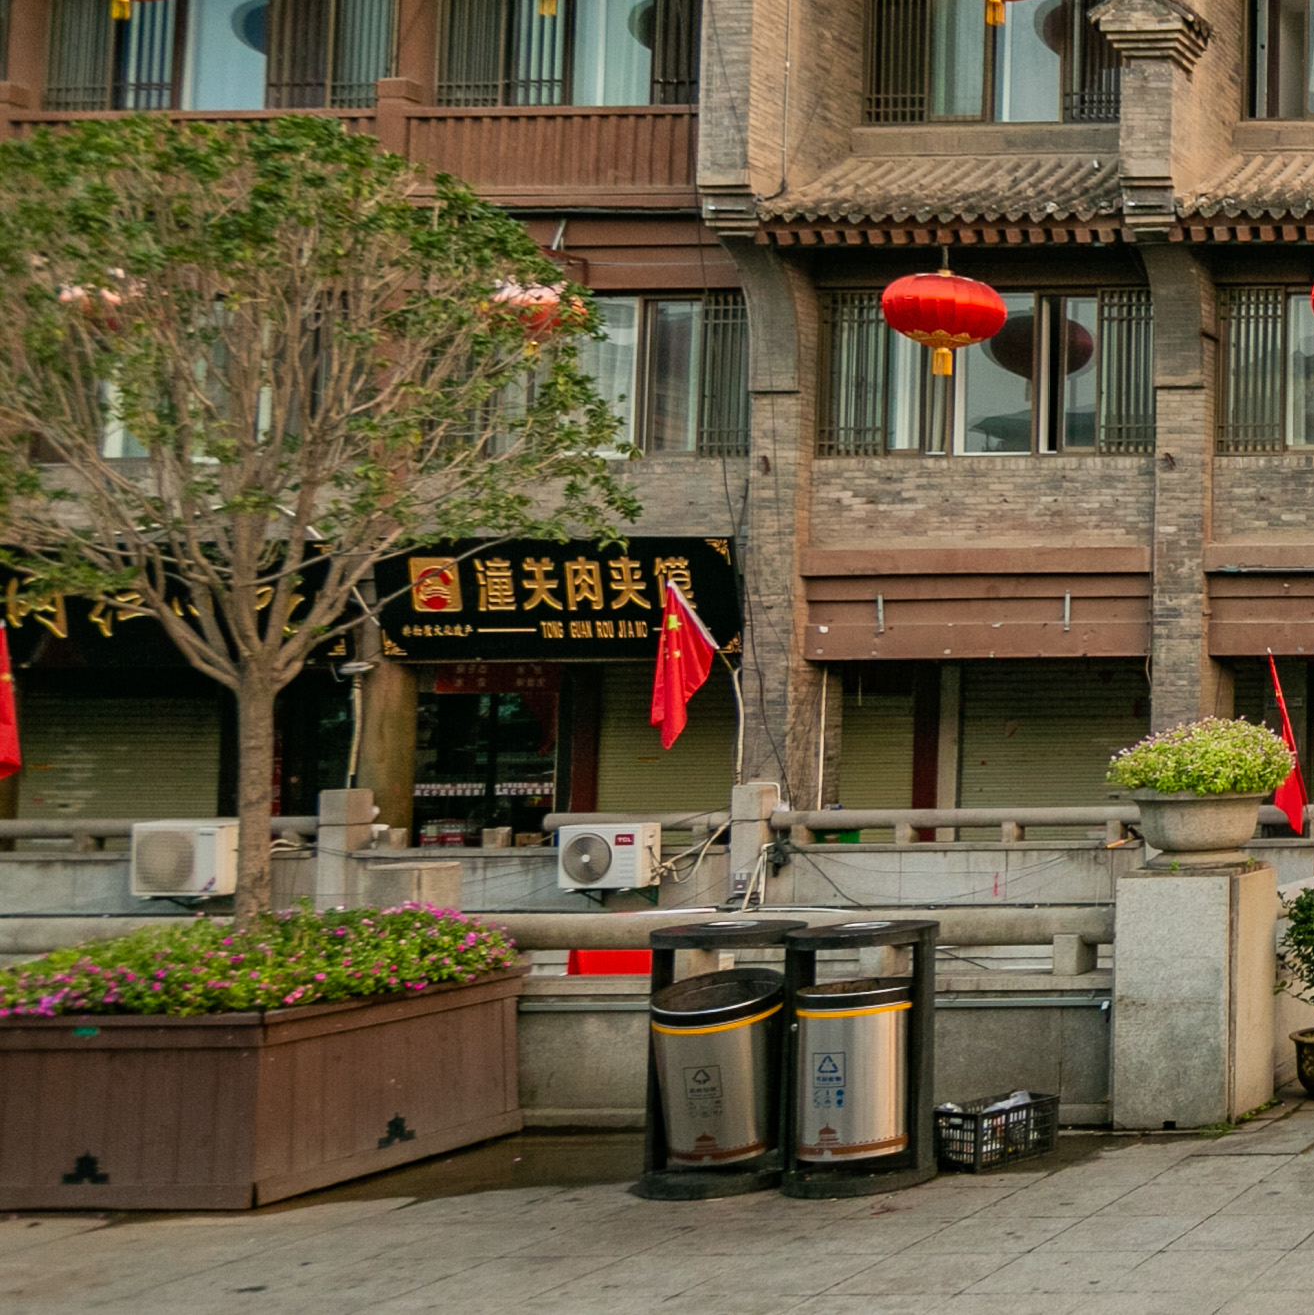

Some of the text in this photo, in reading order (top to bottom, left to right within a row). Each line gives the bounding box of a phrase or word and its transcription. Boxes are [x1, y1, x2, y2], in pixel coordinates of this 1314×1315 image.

[473, 556, 698, 611] 潼关肉夹馍
[539, 620, 564, 639] TONG
[568, 620, 594, 639] GUAN
[595, 620, 615, 639] ROU
